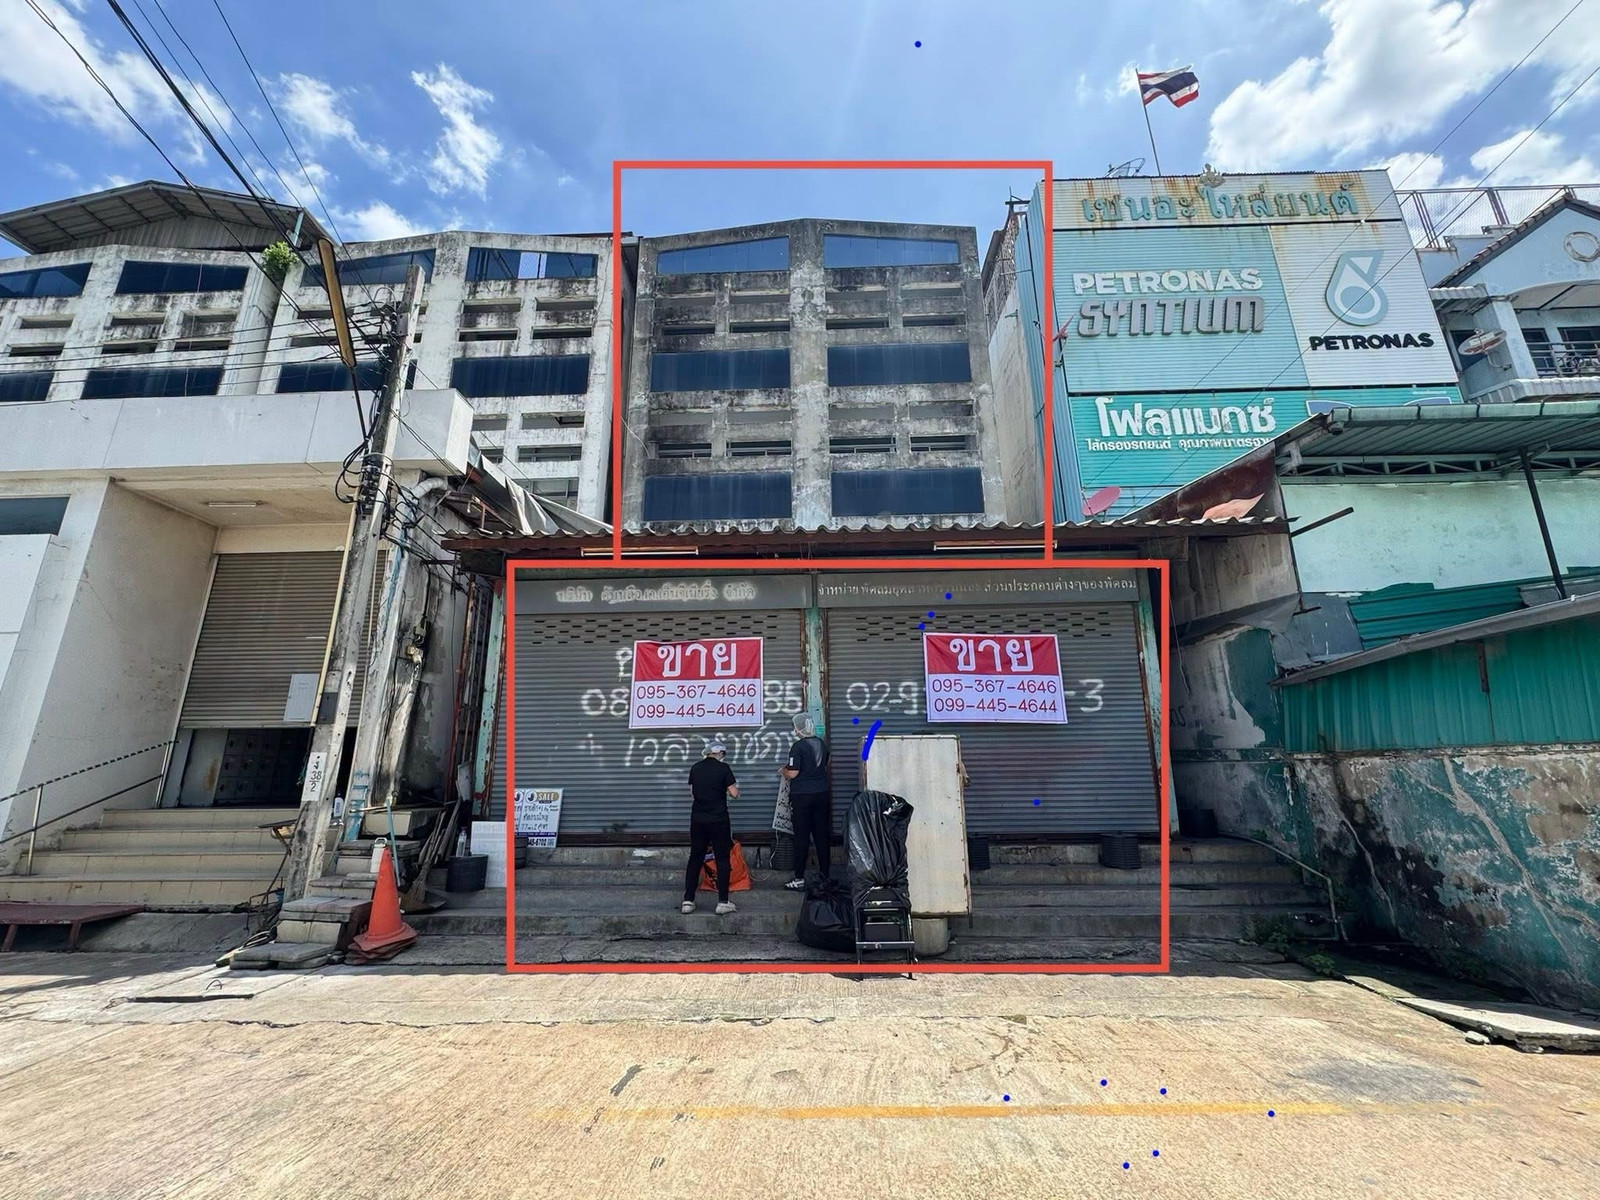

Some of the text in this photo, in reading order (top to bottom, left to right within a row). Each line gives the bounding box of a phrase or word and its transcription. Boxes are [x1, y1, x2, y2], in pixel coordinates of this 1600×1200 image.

[1072, 267, 1263, 295] PETRONAS
[1078, 296, 1265, 336] SYNTIUM
[1309, 333, 1434, 350] PETRONAS
[1095, 396, 1276, 437] โฟลแมกซ์
[1178, 436, 1273, 452] คุณภาพมาตรฐา
[657, 643, 737, 678] ขาย
[949, 638, 1034, 672] ขาย
[637, 684, 757, 700] 095-367-4646
[932, 679, 1057, 695] 095-367-4646
[636, 703, 756, 719] 099-445-4644
[934, 697, 1058, 713] 099-445-4644
